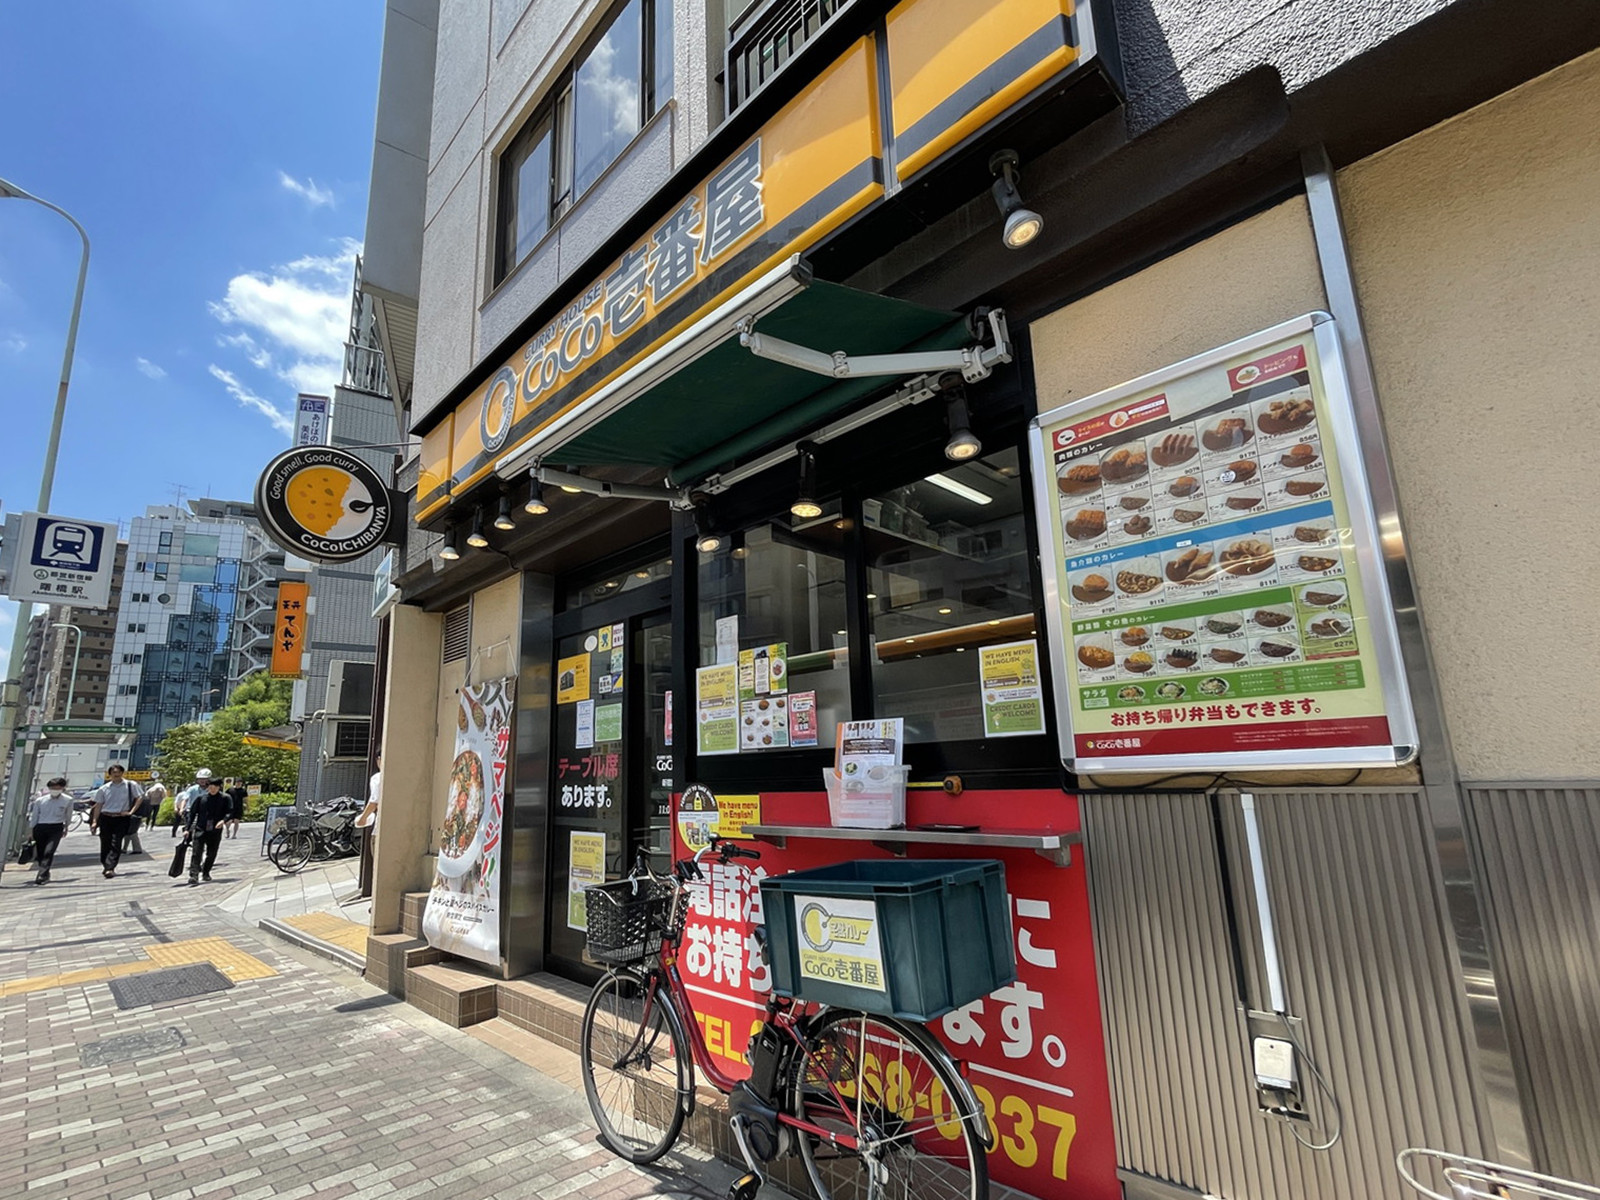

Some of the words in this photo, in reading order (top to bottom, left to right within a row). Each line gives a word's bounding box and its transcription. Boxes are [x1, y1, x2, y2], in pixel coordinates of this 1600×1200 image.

[524, 320, 560, 361] CURRY
[560, 280, 603, 333] HOUSE
[270, 473, 284, 499] Good
[281, 456, 305, 478] smell.
[304, 453, 333, 464] Good
[333, 457, 359, 473] curry
[300, 506, 387, 552] CoCoICHIBANYA
[283, 600, 301, 609] 天丼
[283, 615, 296, 651] てんや
[985, 652, 994, 660] WE
[996, 650, 1012, 658] HAVE
[1013, 648, 1032, 656] MENU
[992, 657, 1020, 666] ENGLISH
[1083, 688, 1108, 699] サラダ
[990, 704, 1012, 713] CREDIT
[1013, 702, 1036, 711] CARDS
[1110, 697, 1321, 727] お持ち帰り弁当もできます。
[1096, 738, 1141, 749] CoCo壱番屋
[558, 753, 619, 778] テーブル席
[561, 784, 611, 808] あります。
[719, 801, 726, 809] We
[726, 801, 741, 809] have
[729, 810, 753, 819] English!
[804, 959, 880, 985] CoCo壱番屋
